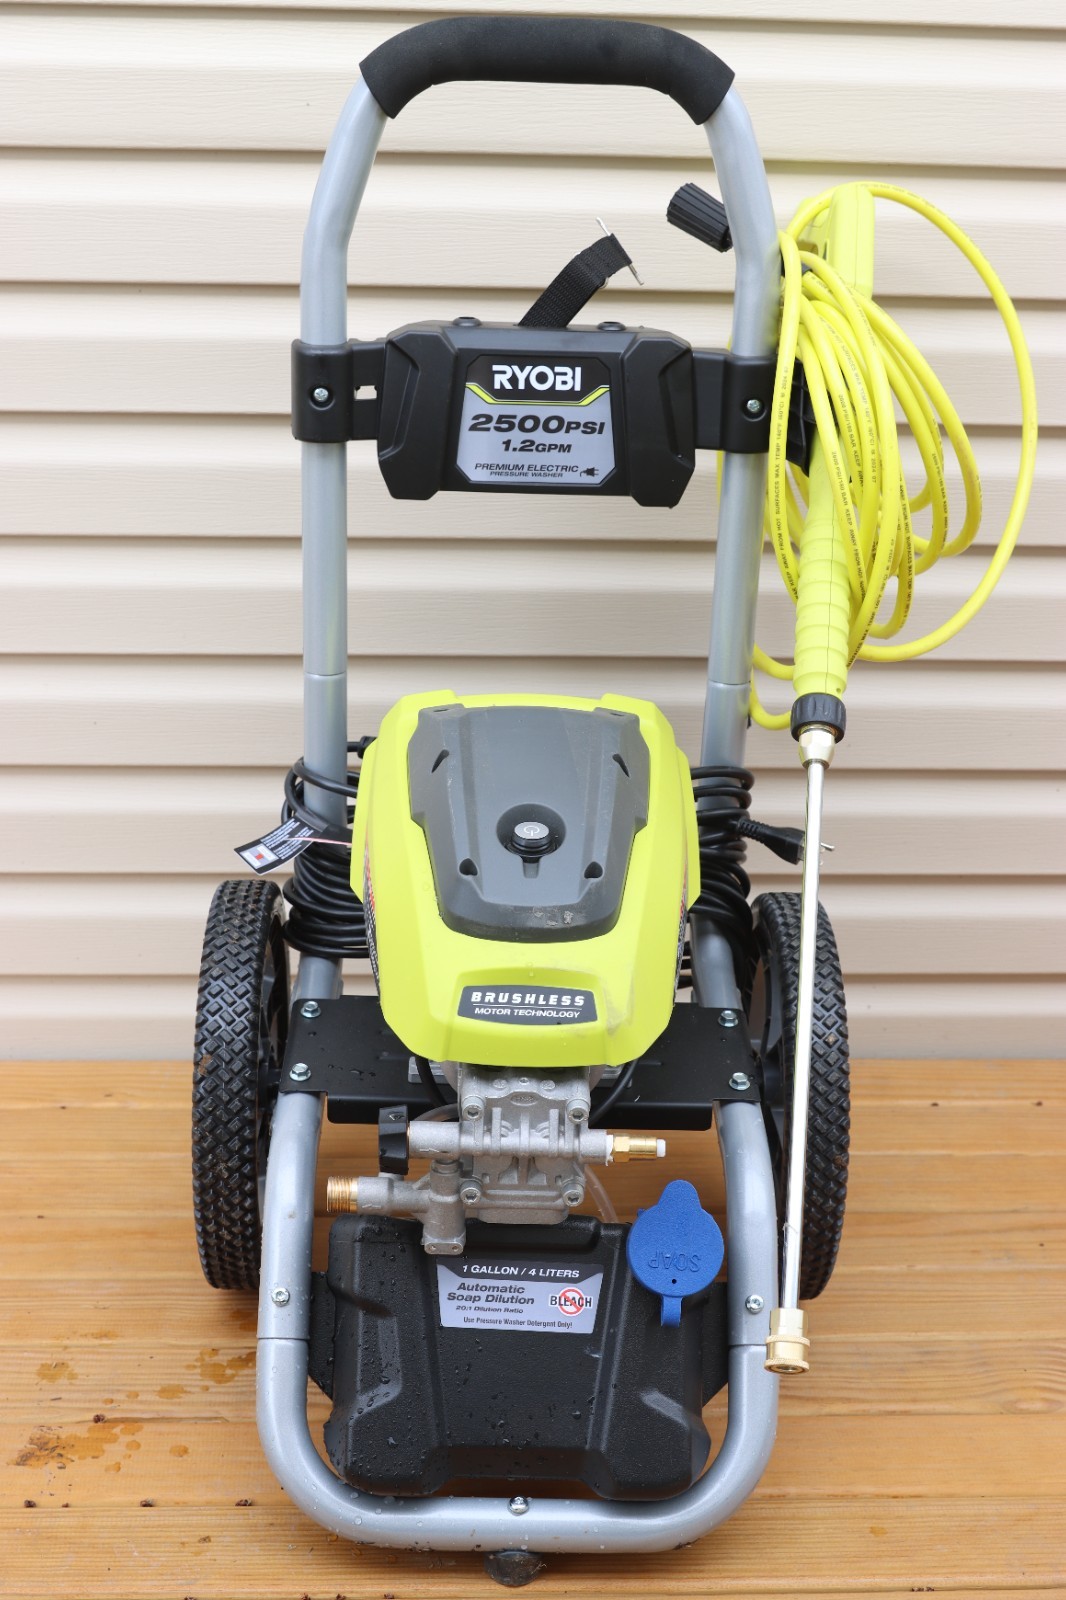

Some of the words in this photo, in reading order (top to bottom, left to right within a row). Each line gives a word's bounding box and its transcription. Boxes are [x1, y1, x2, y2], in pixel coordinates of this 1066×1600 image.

[492, 364, 582, 391] RYOBI
[468, 413, 606, 434] 2500PSI
[502, 439, 572, 454] 1.2GPM
[474, 462, 524, 471] PREMIUM
[526, 464, 579, 472] ELECTRIC
[471, 991, 585, 1006] BRUSHLESS
[474, 1007, 510, 1016] MOTOR
[514, 1008, 580, 1018] TECHNOLOGY
[648, 1250, 701, 1272] SOAP
[462, 1264, 468, 1272] 1
[470, 1265, 518, 1276] GALLON
[520, 1267, 526, 1276] /
[528, 1268, 536, 1276] 4
[539, 1268, 580, 1278] LITERS
[456, 1282, 525, 1294] Automatic
[446, 1292, 481, 1304] Soap
[484, 1294, 535, 1305] Dilution
[550, 1295, 592, 1308] BLEACH
[557, 1320, 573, 1329] Only!
